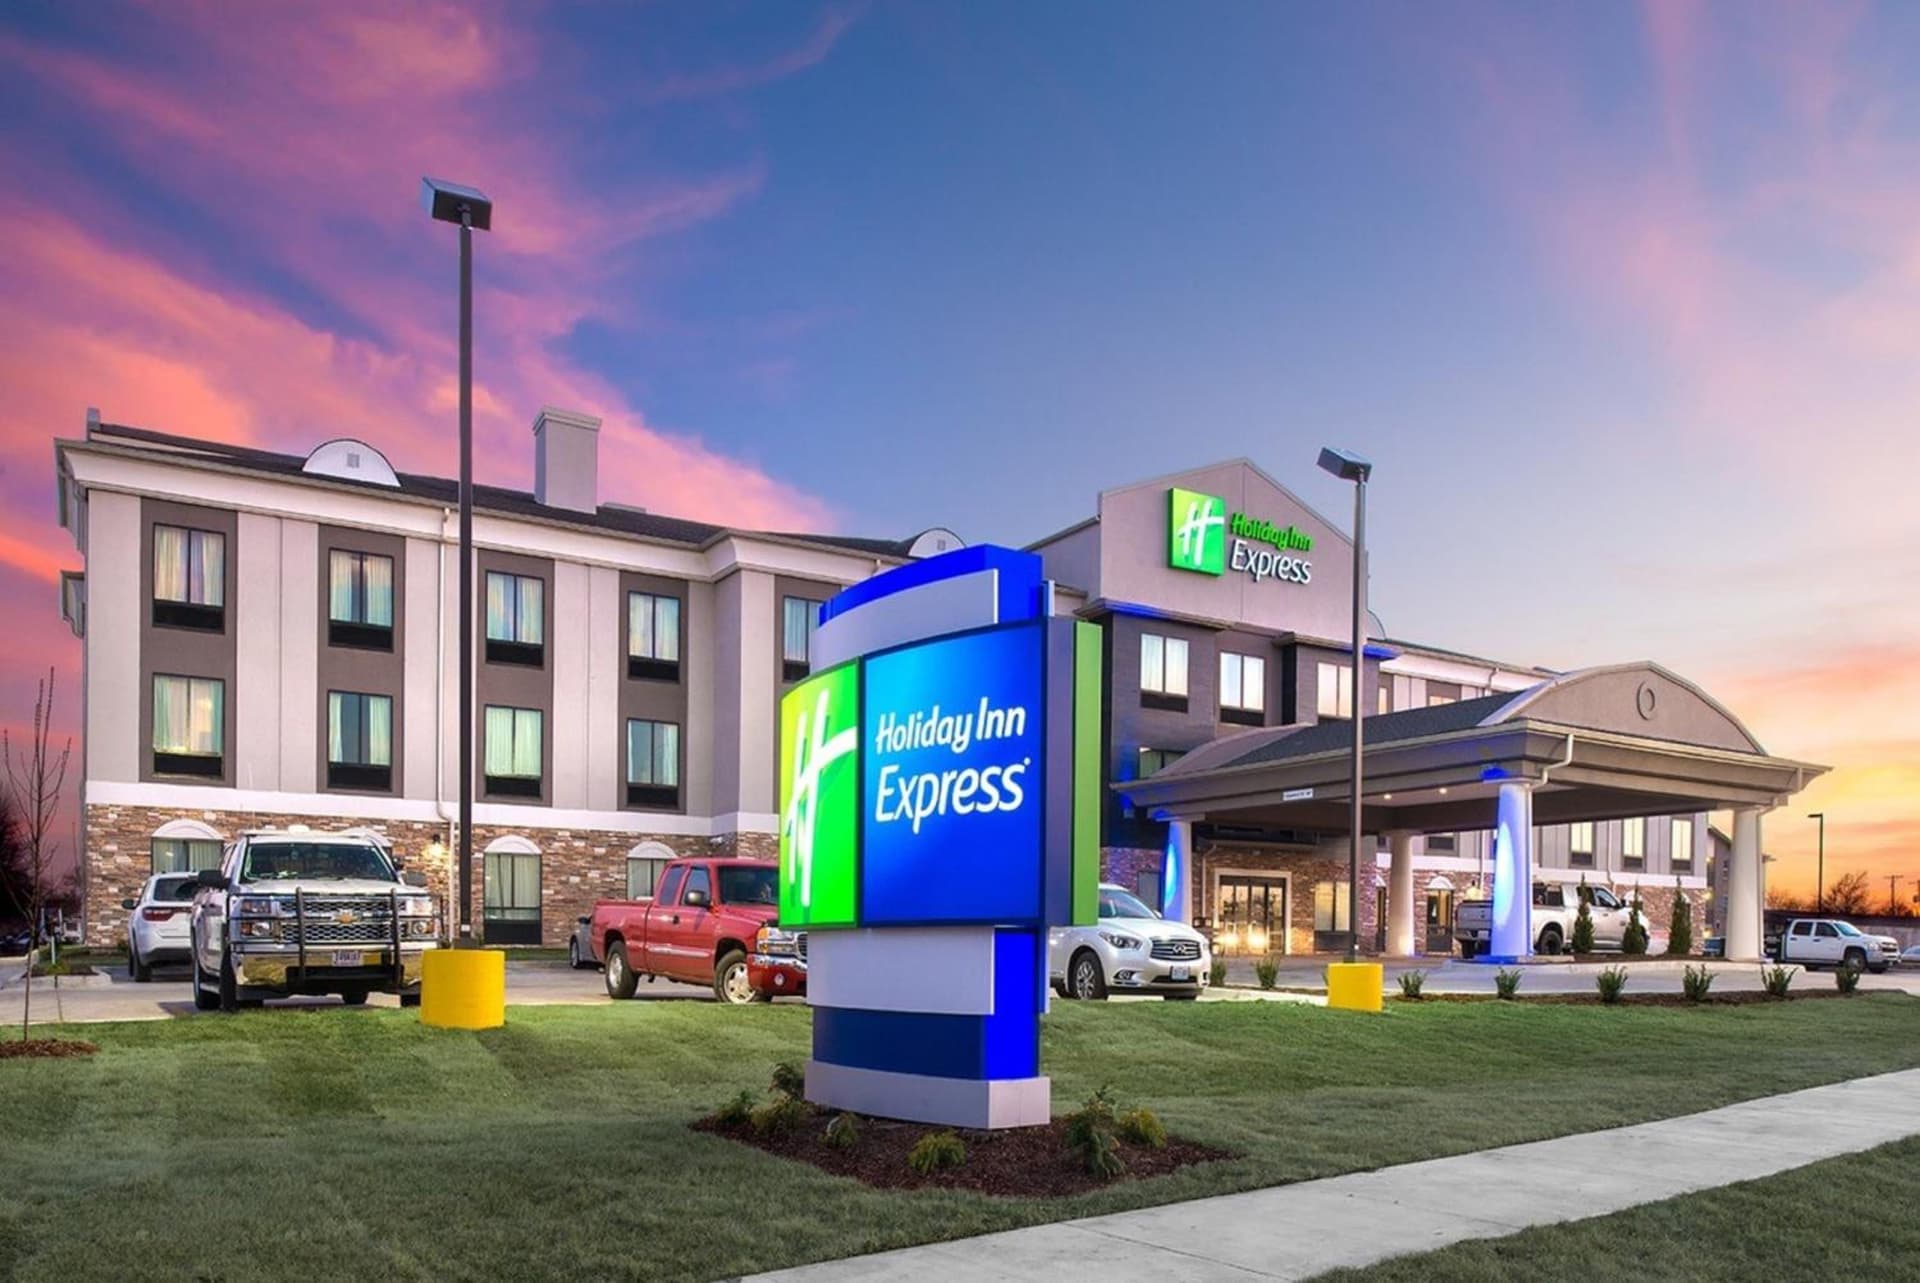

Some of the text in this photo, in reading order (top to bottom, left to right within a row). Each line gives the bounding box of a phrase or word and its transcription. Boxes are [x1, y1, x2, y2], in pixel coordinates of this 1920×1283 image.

[1231, 512, 1313, 551] Holiday Inn
[1230, 539, 1312, 584] Express
[875, 696, 1026, 754] Holiday Inn
[875, 763, 1027, 835] Express
